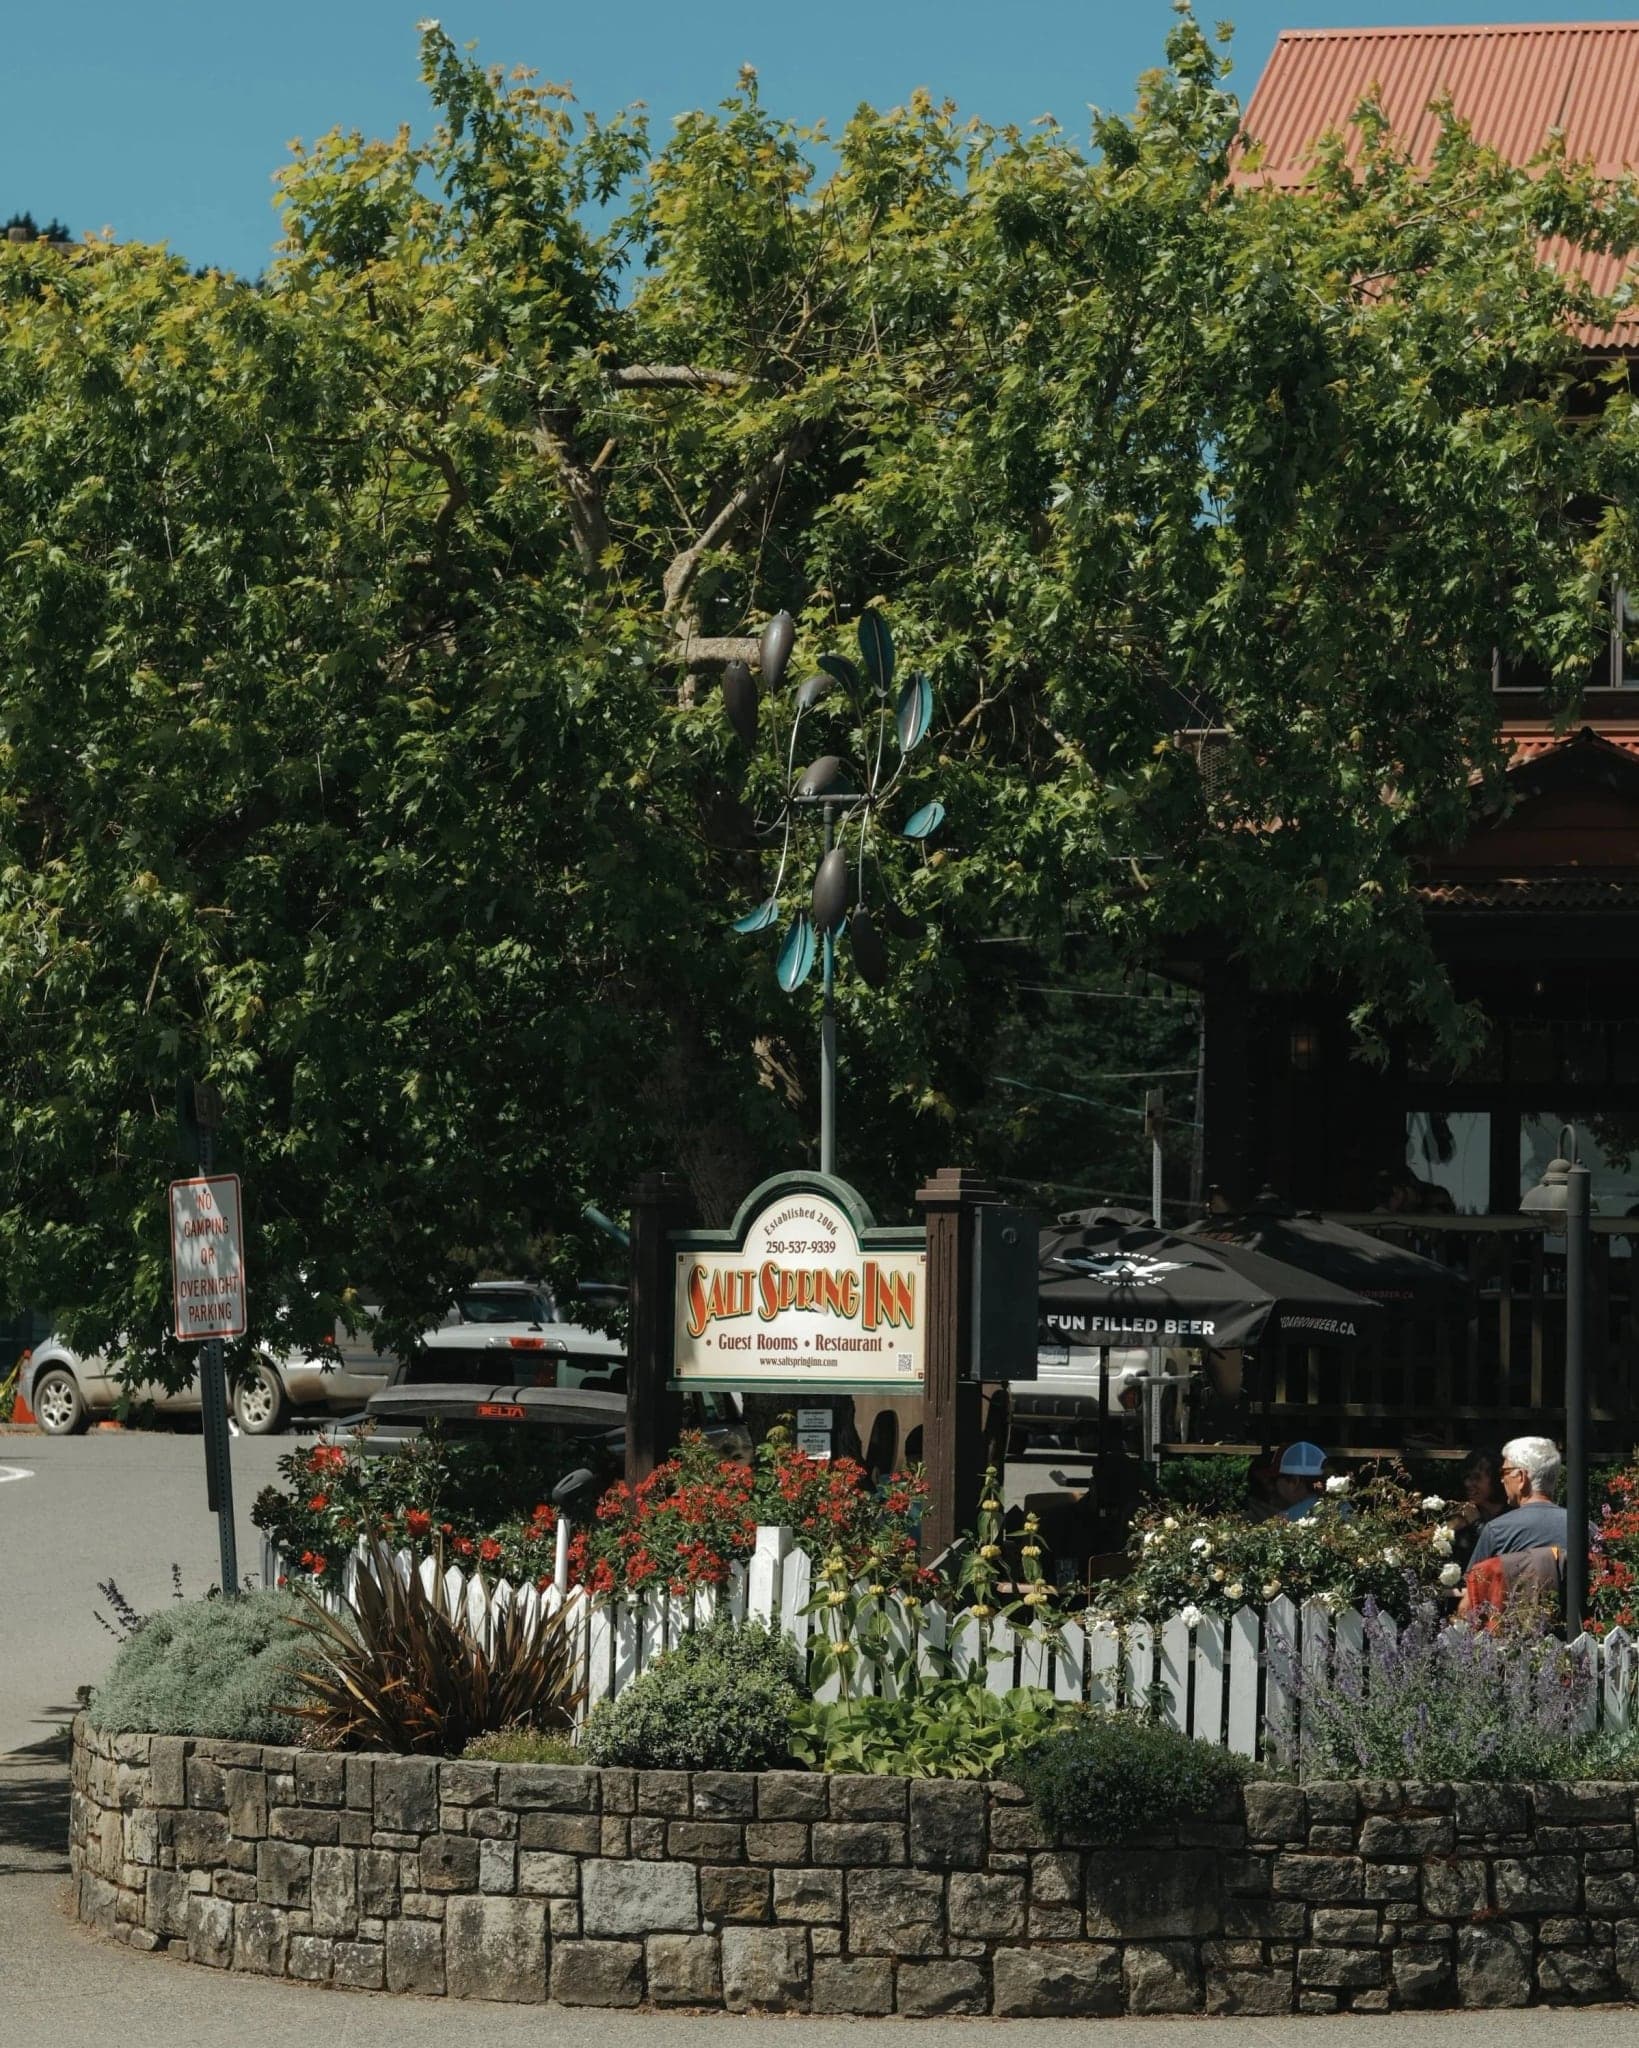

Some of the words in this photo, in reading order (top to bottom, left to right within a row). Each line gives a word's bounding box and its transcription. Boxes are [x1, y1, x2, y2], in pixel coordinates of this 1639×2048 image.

[196, 1192, 212, 1211] NO
[184, 1216, 229, 1239] CAMPING
[764, 1207, 816, 1236] Established
[817, 1212, 839, 1236] 2006
[200, 1247, 215, 1265] OR
[765, 1240, 836, 1254] 250-537-9339
[180, 1276, 238, 1298] OVERNIGHT
[188, 1302, 232, 1323] PARKING
[1047, 1314, 1085, 1330] FUN
[1092, 1316, 1158, 1333] FILLED
[1164, 1319, 1215, 1336] BEER
[718, 1333, 751, 1350] Guest
[757, 1334, 798, 1350] Rooms
[815, 1334, 882, 1351] Restaurant
[759, 1356, 838, 1368] www.saltspringinn.com
